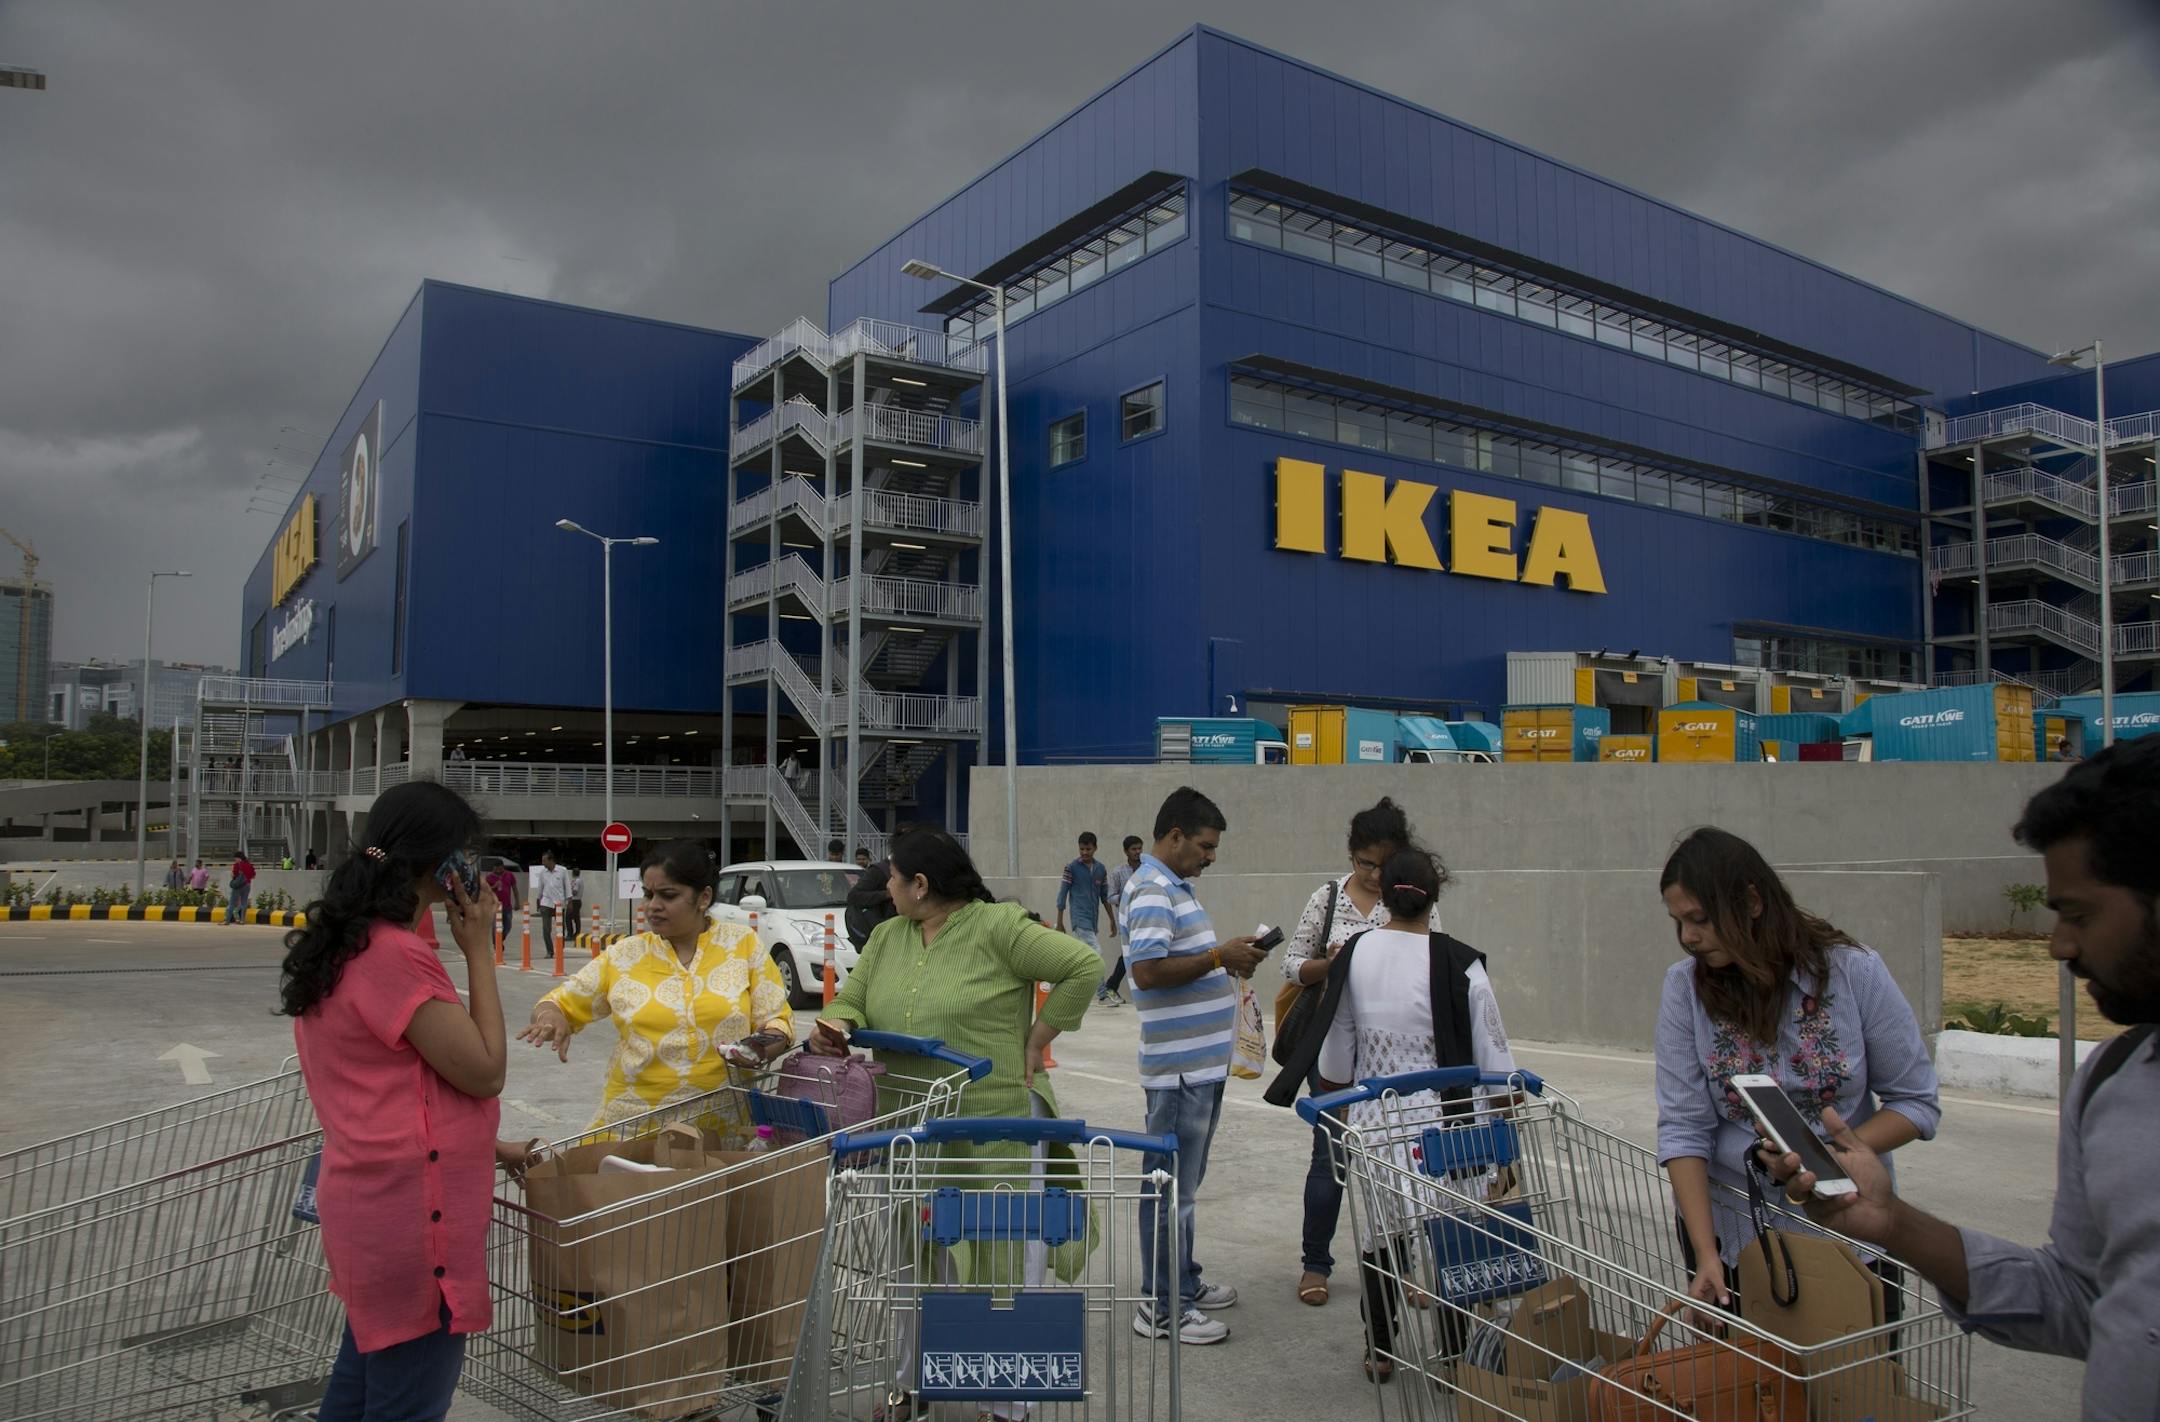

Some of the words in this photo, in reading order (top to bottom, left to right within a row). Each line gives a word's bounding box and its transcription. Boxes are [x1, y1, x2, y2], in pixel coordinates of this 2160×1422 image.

[1274, 456, 1608, 595] IKEA
[272, 491, 315, 609] IKEA
[1900, 714, 1934, 726] GATI
[1935, 709, 1965, 723] KWE
[2131, 712, 2160, 725] KWE
[1684, 721, 1718, 731] GATI
[1192, 735, 1210, 744] ATI
[1210, 733, 1236, 744] KWE
[1527, 729, 1557, 738] GATI
[1615, 749, 1647, 758] GATI
